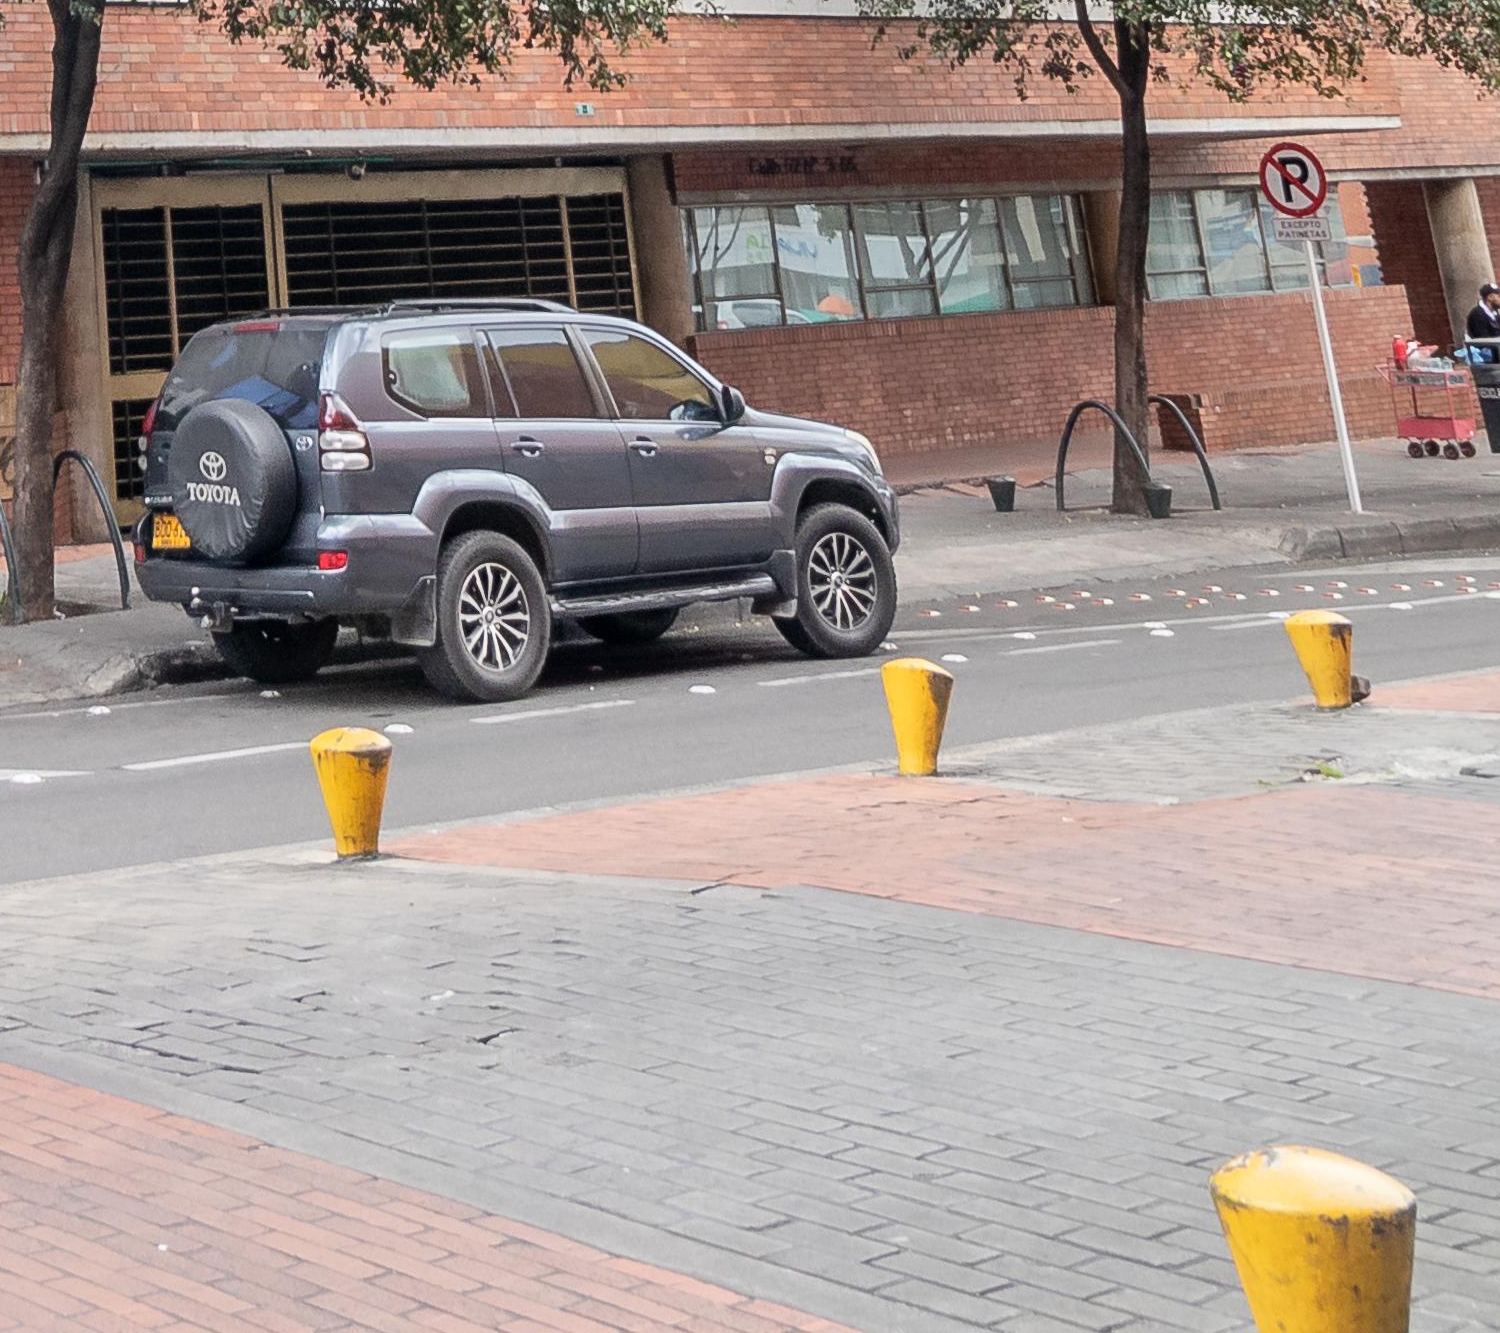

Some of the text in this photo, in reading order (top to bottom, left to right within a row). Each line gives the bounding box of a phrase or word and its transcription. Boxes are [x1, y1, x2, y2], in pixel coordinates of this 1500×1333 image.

[1280, 220, 1321, 229] EXCEPTO
[1278, 230, 1328, 239] PATINETAS
[186, 482, 241, 507] TOYOTA
